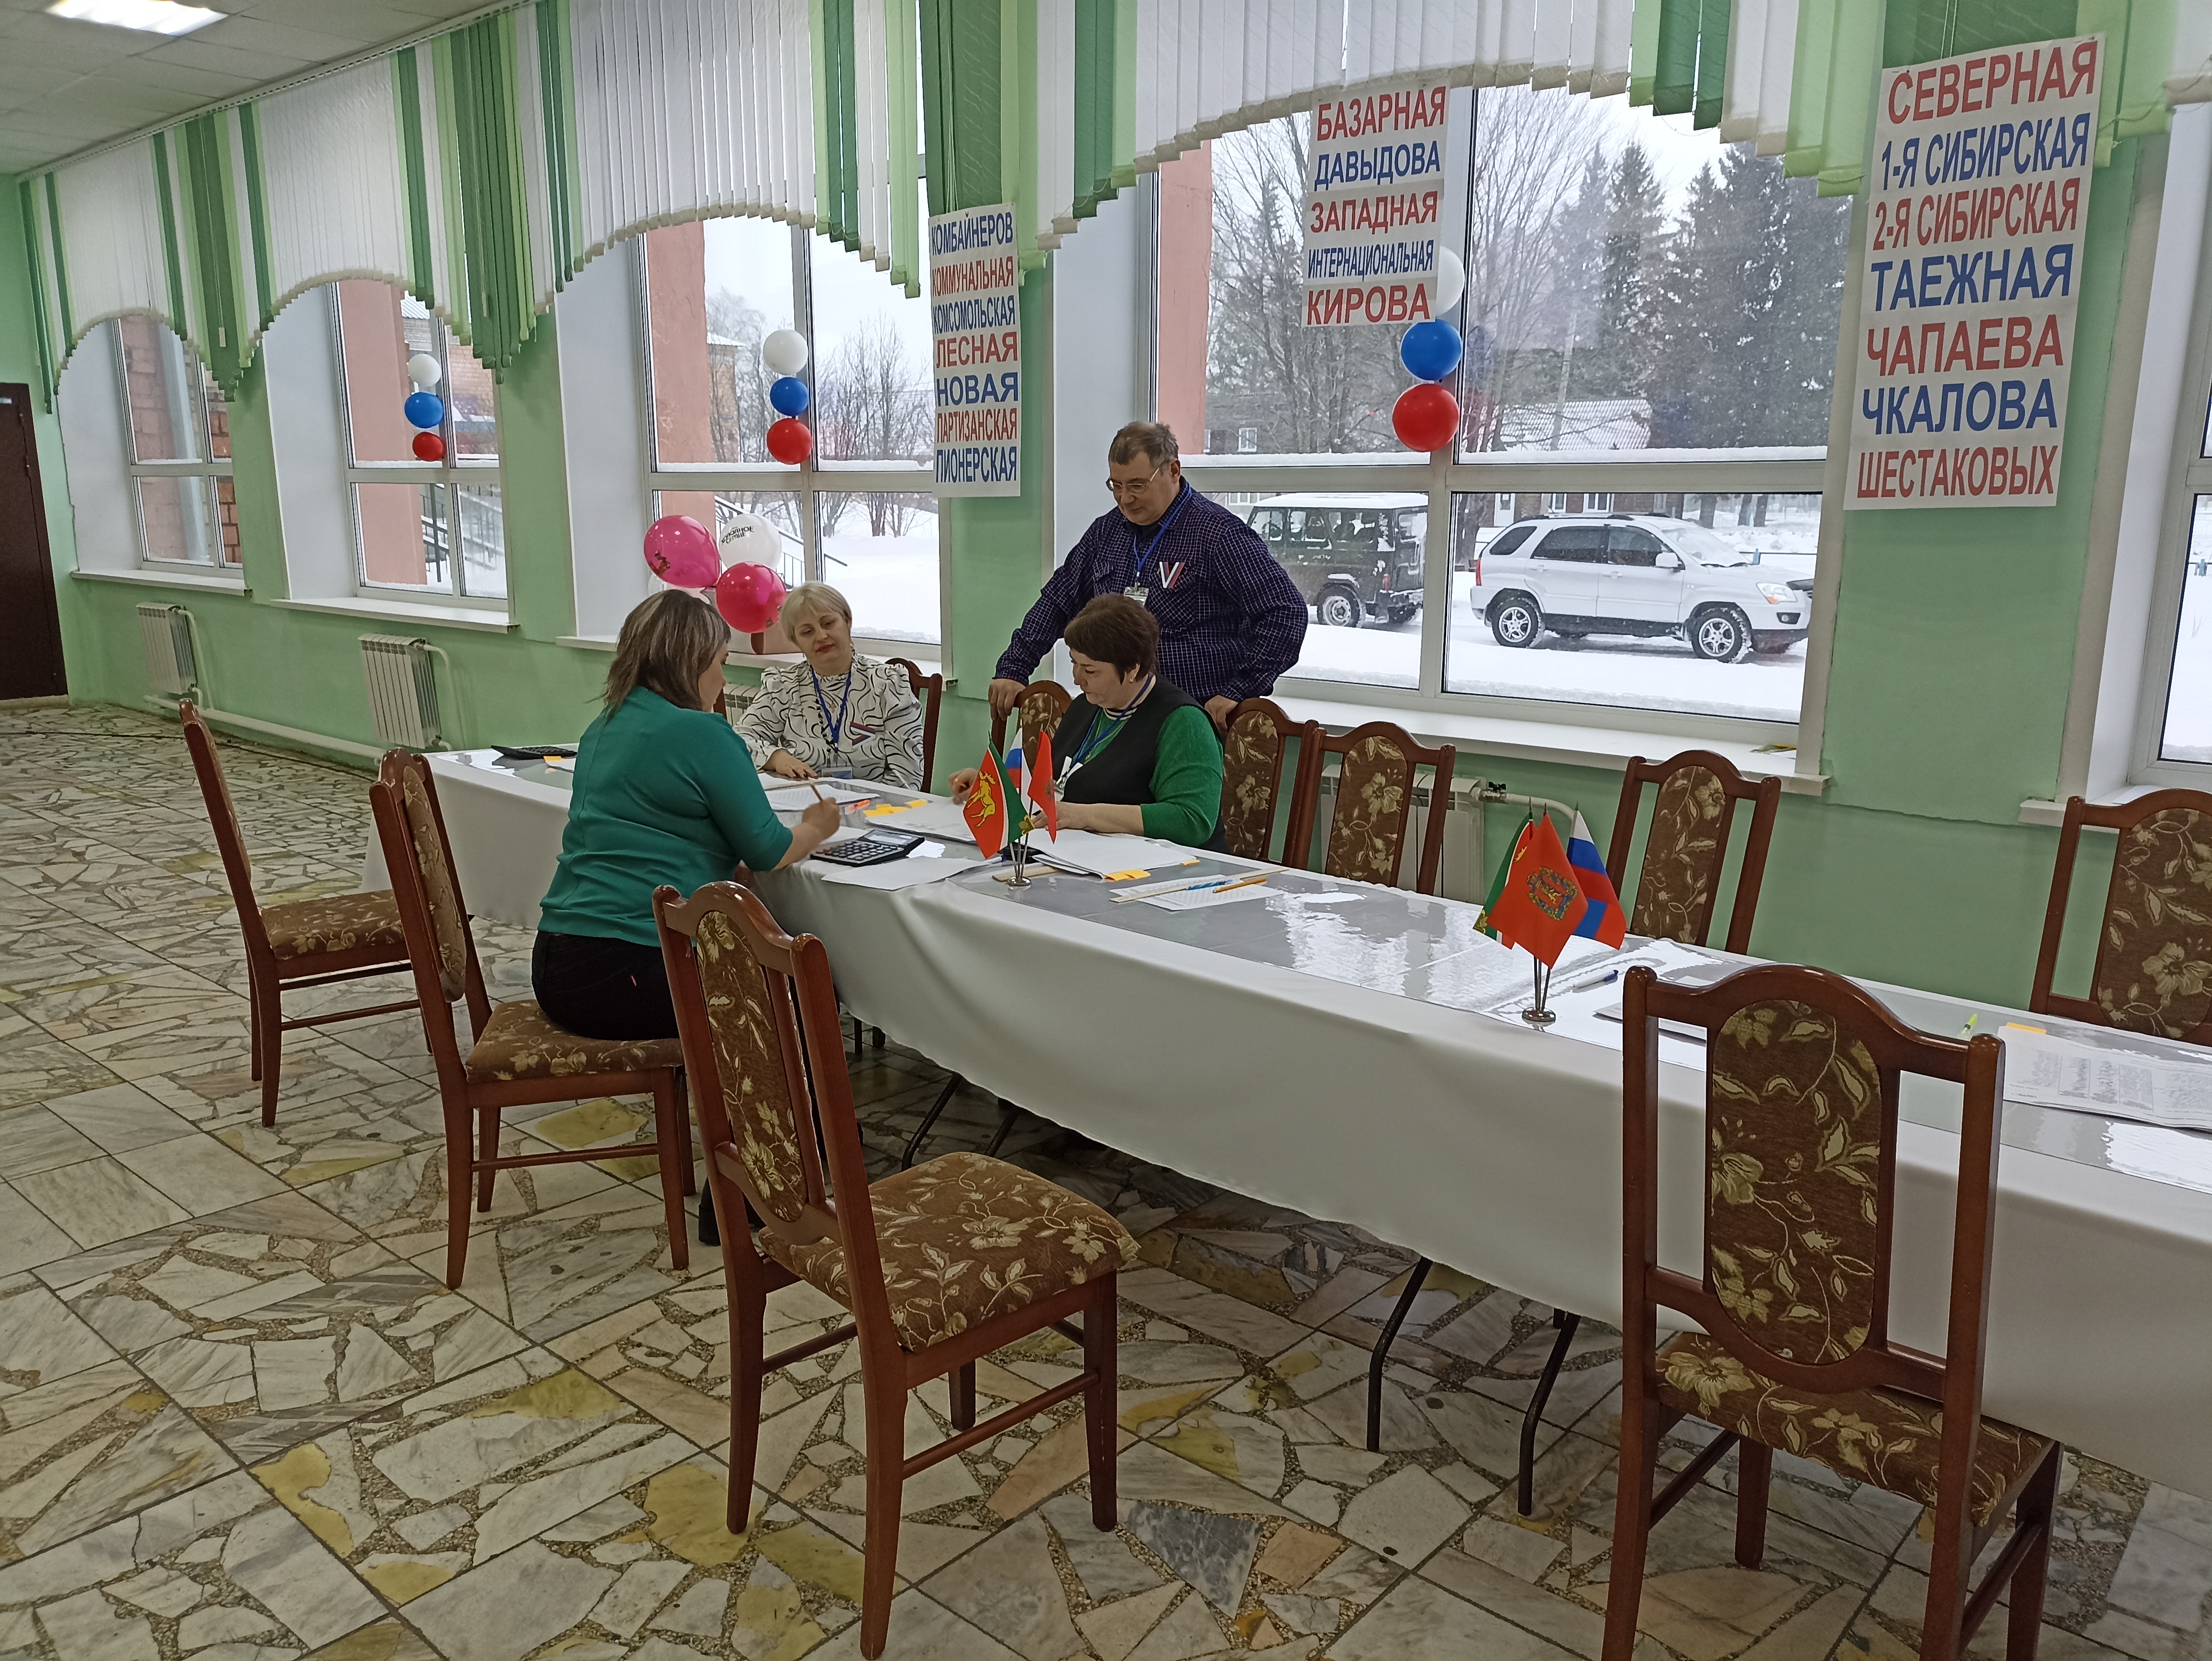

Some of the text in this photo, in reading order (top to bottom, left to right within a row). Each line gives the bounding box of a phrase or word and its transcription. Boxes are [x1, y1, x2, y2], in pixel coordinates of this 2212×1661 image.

[1888, 41, 2098, 124] СЕВЕРНАЯ
[1317, 86, 1446, 141] БАЗАРНАЯ
[1314, 141, 1440, 191] ДАВЫДОВА
[1881, 113, 2091, 190] 1-Я СИБИРСКАЯ
[932, 211, 1013, 256] КОМБАЙНЕРОВ
[1310, 191, 1438, 234] ЗАПАДНАЯ
[1872, 177, 2080, 251] 2-Я СИБИРСКАЯ
[932, 256, 1014, 297] КОММУНАЛЬНАЯ
[1308, 240, 1434, 281] ИНТЕРНАЦИОНАЛЬНАЯ
[1870, 244, 2074, 311] ТАЕЖНАЯ
[933, 295, 1015, 334] КОМСОМОЛЬСКАЯ
[1307, 283, 1430, 325] КИРОВА
[936, 332, 1018, 368] ЛЕСНАЯ
[1867, 314, 2063, 376] ЧАПАЕВА
[937, 372, 1018, 407] НОВАЯ
[1862, 378, 2057, 434] ЧКАЛОВА
[937, 408, 1017, 443] ПАРТИЗАНСКАЯ
[936, 446, 1017, 483] ПИОНЕРСКАЯ
[1857, 445, 2058, 498] ШЕСТАКОВЫХ
